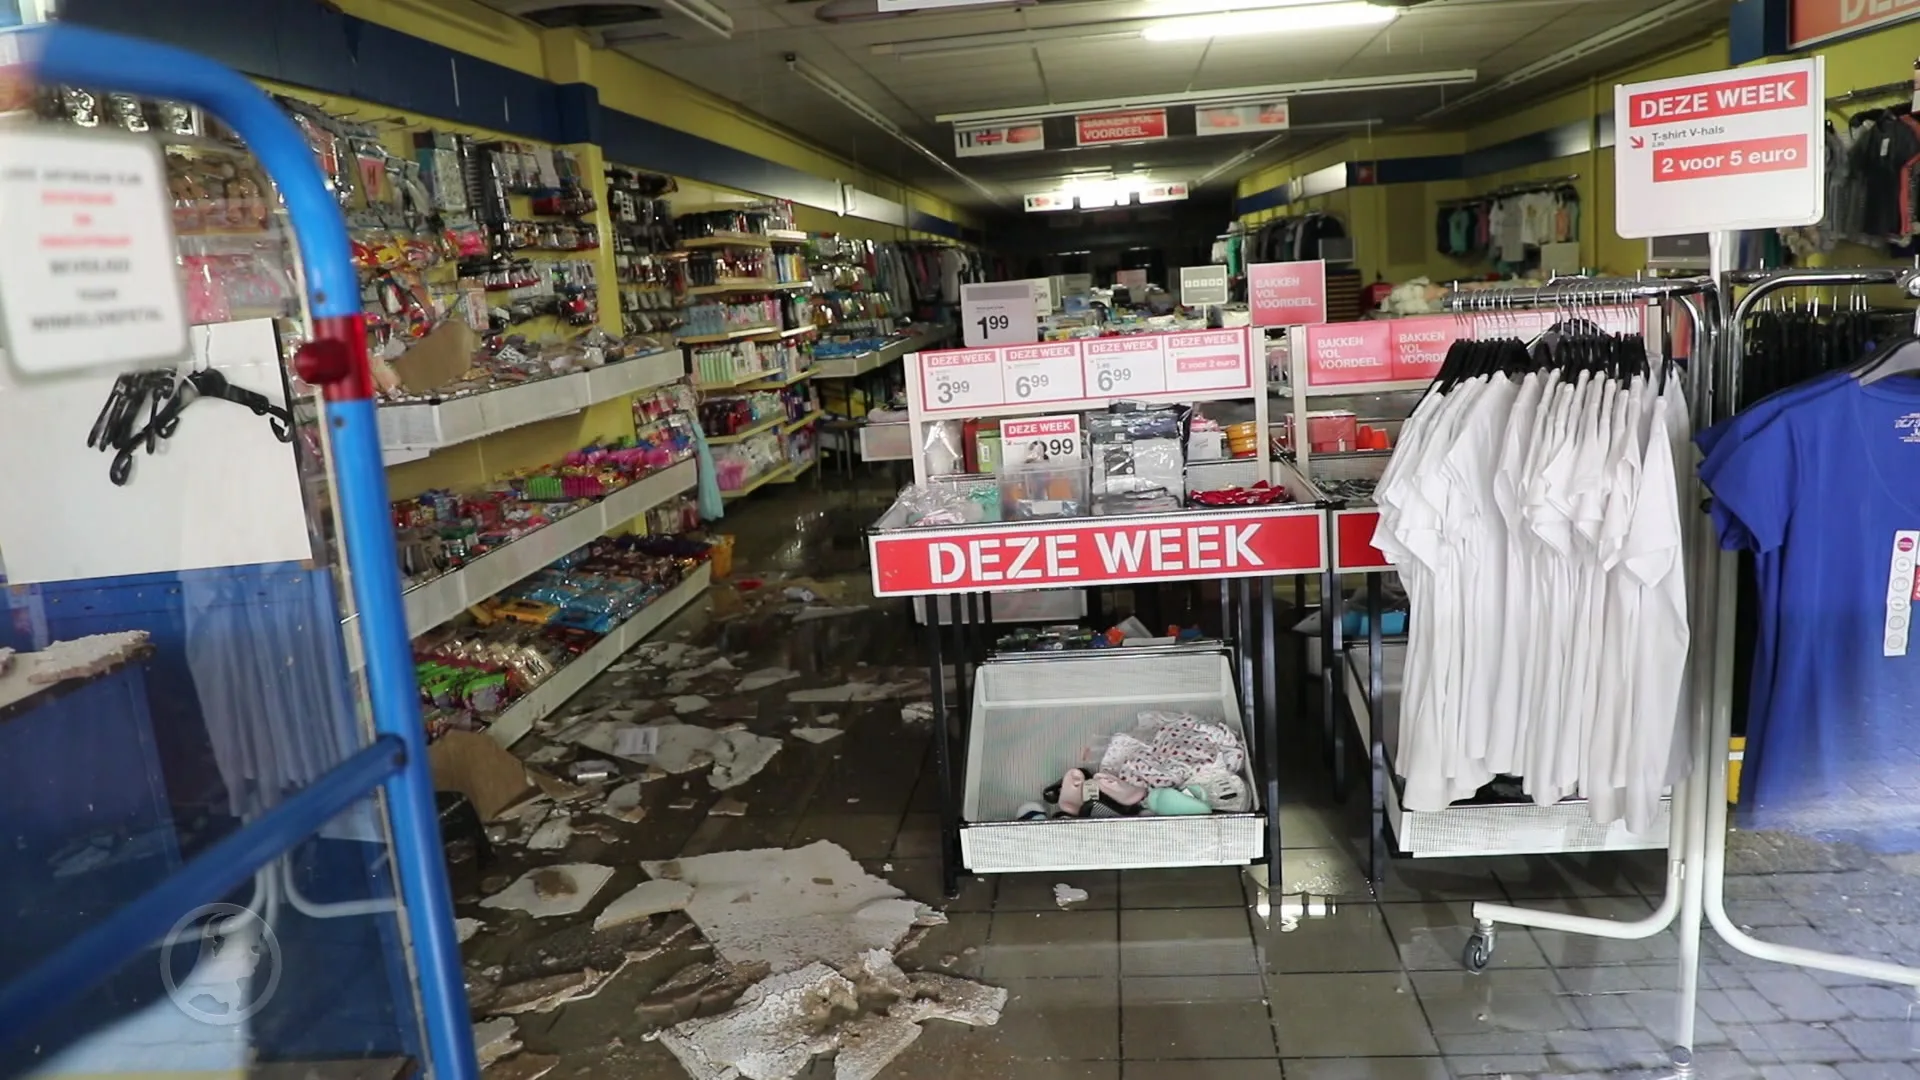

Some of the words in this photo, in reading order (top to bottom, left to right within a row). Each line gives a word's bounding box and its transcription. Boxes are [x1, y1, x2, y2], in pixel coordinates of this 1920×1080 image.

[1640, 92, 1709, 120] DEZE
[1716, 80, 1797, 109] WEEK
[1651, 129, 1687, 142] T-shirt
[1689, 125, 1725, 137] V-hals
[1661, 157, 1674, 174] 2
[1679, 155, 1725, 171] voor
[1729, 149, 1743, 167] 5
[1748, 148, 1797, 165] euro
[1255, 277, 1300, 288] BAKKEN
[1255, 288, 1278, 298] VOL
[1172, 337, 1201, 347] DEZE
[1203, 334, 1236, 344] WEEK
[1317, 336, 1364, 348] BAKKEN
[1399, 331, 1446, 343] BAKKEN
[1010, 349, 1039, 360] DEZE
[1040, 346, 1071, 357] WEEK
[1092, 343, 1121, 353] DEZE
[1123, 340, 1154, 351] WEEK
[1318, 348, 1341, 358] VOL
[1399, 343, 1423, 354] VOL
[931, 356, 959, 366] DEZE
[961, 353, 993, 363] WEEK
[1008, 424, 1039, 435] DEZE
[1040, 421, 1071, 432] WEEK
[928, 534, 1080, 584] DEZE
[1093, 523, 1265, 574] WEEK
